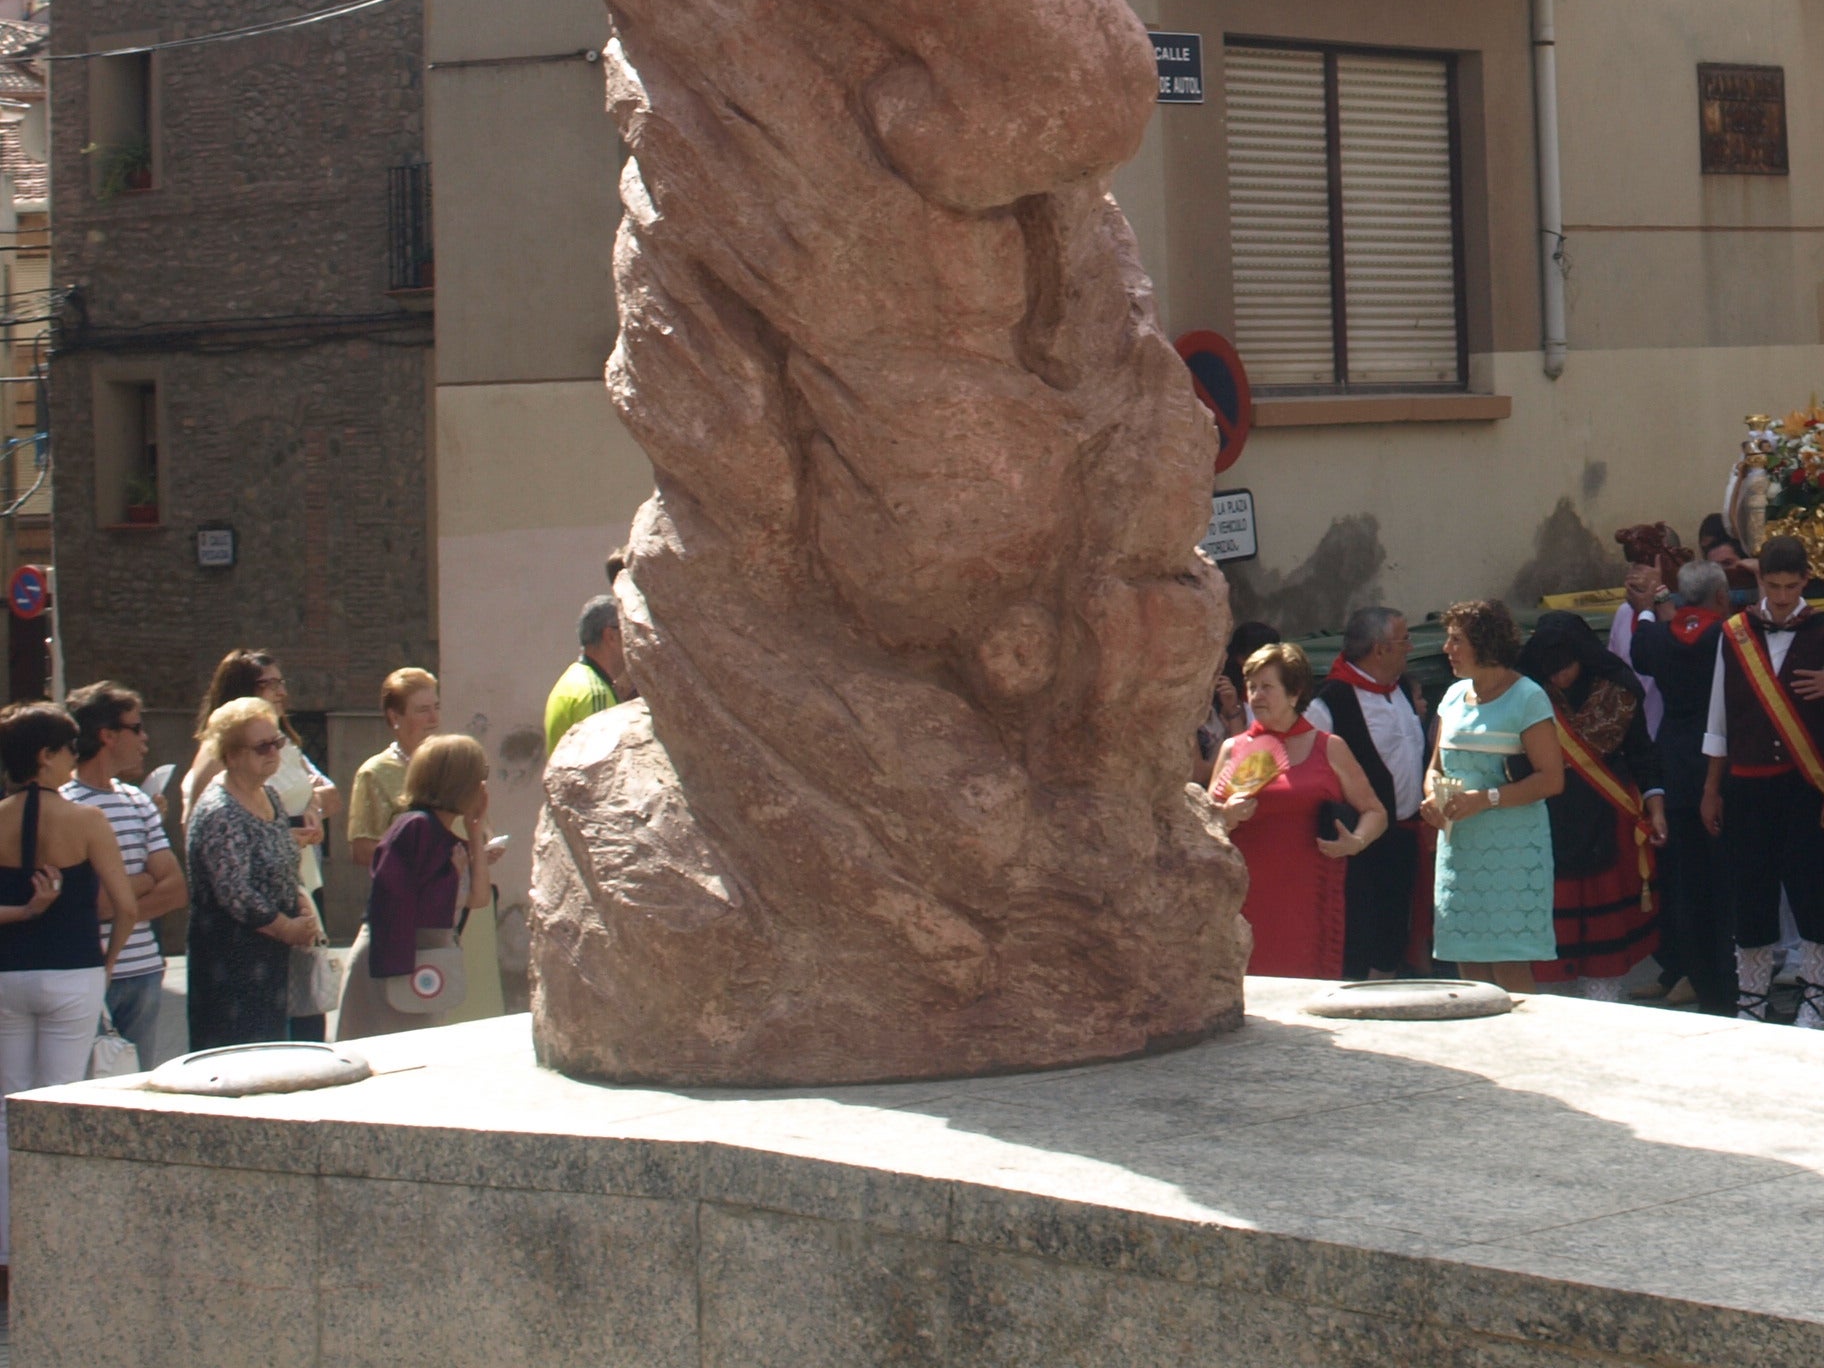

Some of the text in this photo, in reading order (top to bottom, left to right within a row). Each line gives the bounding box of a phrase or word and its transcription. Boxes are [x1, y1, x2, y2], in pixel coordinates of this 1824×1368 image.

[1155, 46, 1191, 61] CALLE
[1159, 76, 1201, 94] DE AUTOL
[1227, 499, 1248, 514] PLAZA
